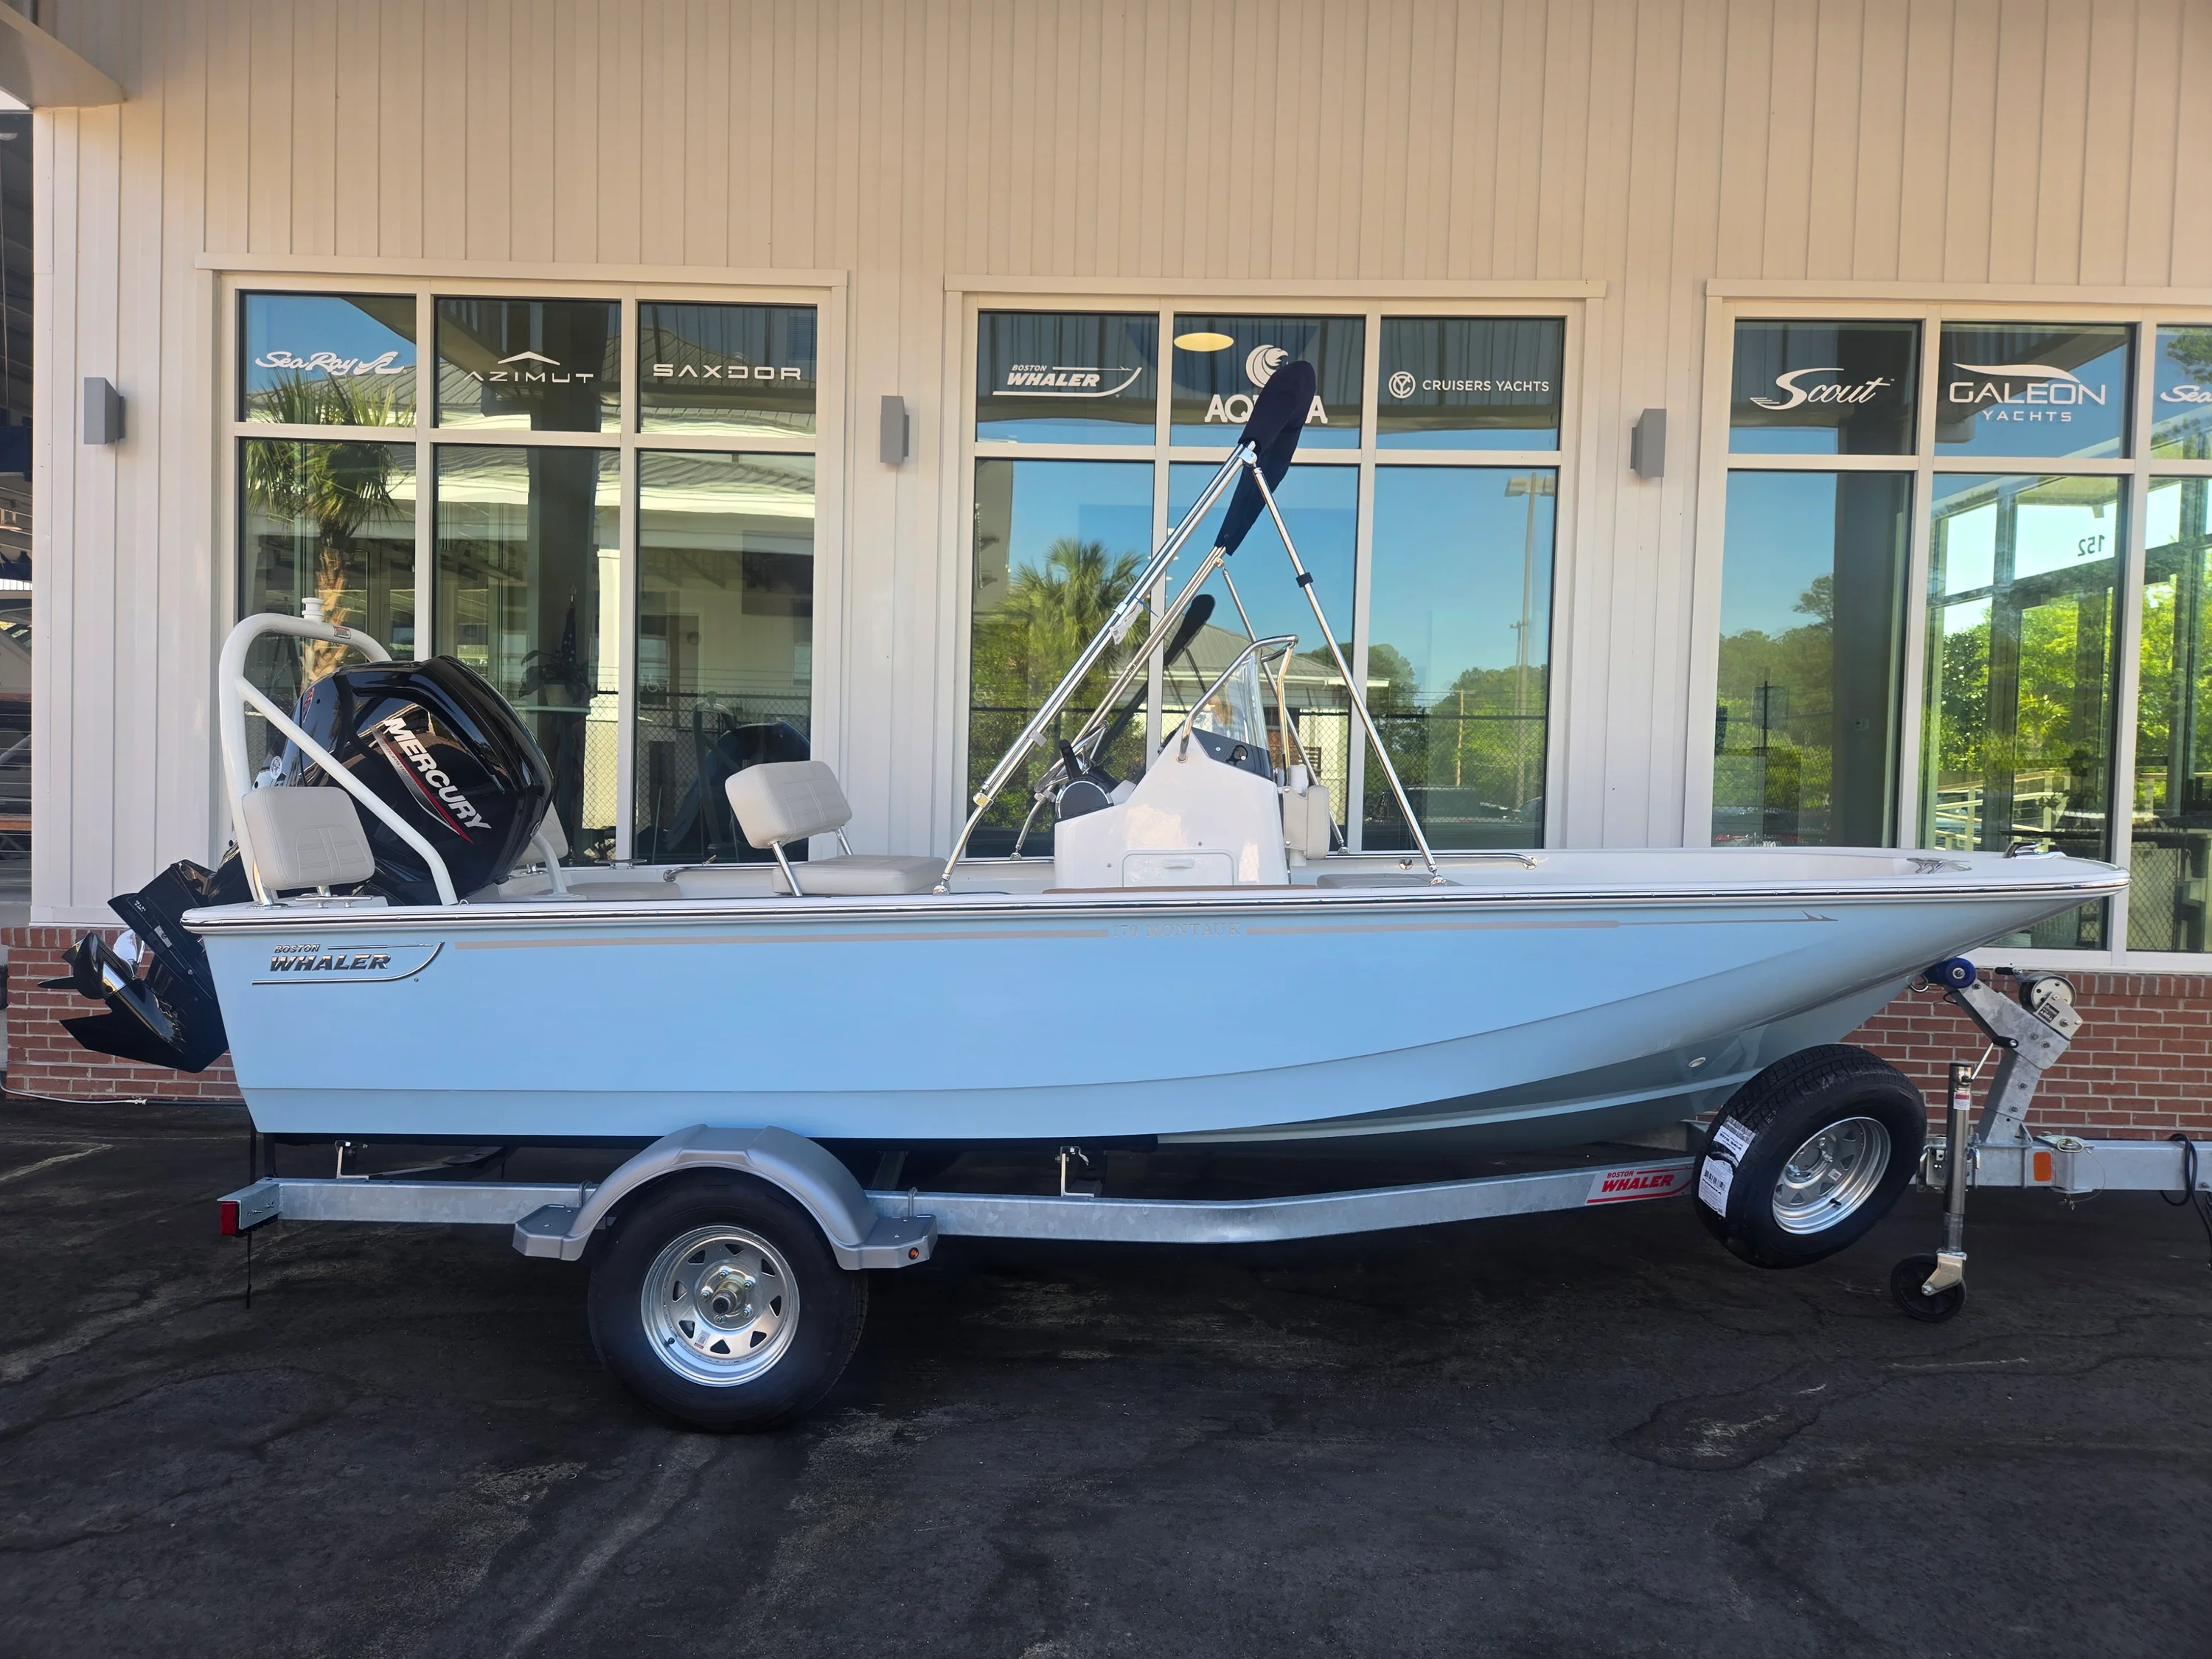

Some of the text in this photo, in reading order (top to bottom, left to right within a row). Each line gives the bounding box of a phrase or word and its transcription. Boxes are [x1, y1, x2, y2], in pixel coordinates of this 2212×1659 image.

[464, 370, 594, 383] AZIMUT
[653, 364, 801, 380] SAXDOR
[1007, 372, 1100, 387] WHALER
[1422, 380, 1550, 392] CRUISERS YACHTS
[1750, 367, 1891, 411] Scout
[1950, 382, 2106, 406] GALEON
[1204, 394, 1328, 423] AQA
[1982, 410, 2072, 422] YACHTS
[383, 717, 492, 830] MERCURY
[1113, 922, 1240, 937] 170 MONTAUK
[274, 944, 321, 953] BOSTON
[270, 953, 391, 972] WHALER
[1607, 1170, 1634, 1179] BOSTON
[1601, 1174, 1674, 1193] WHALER
